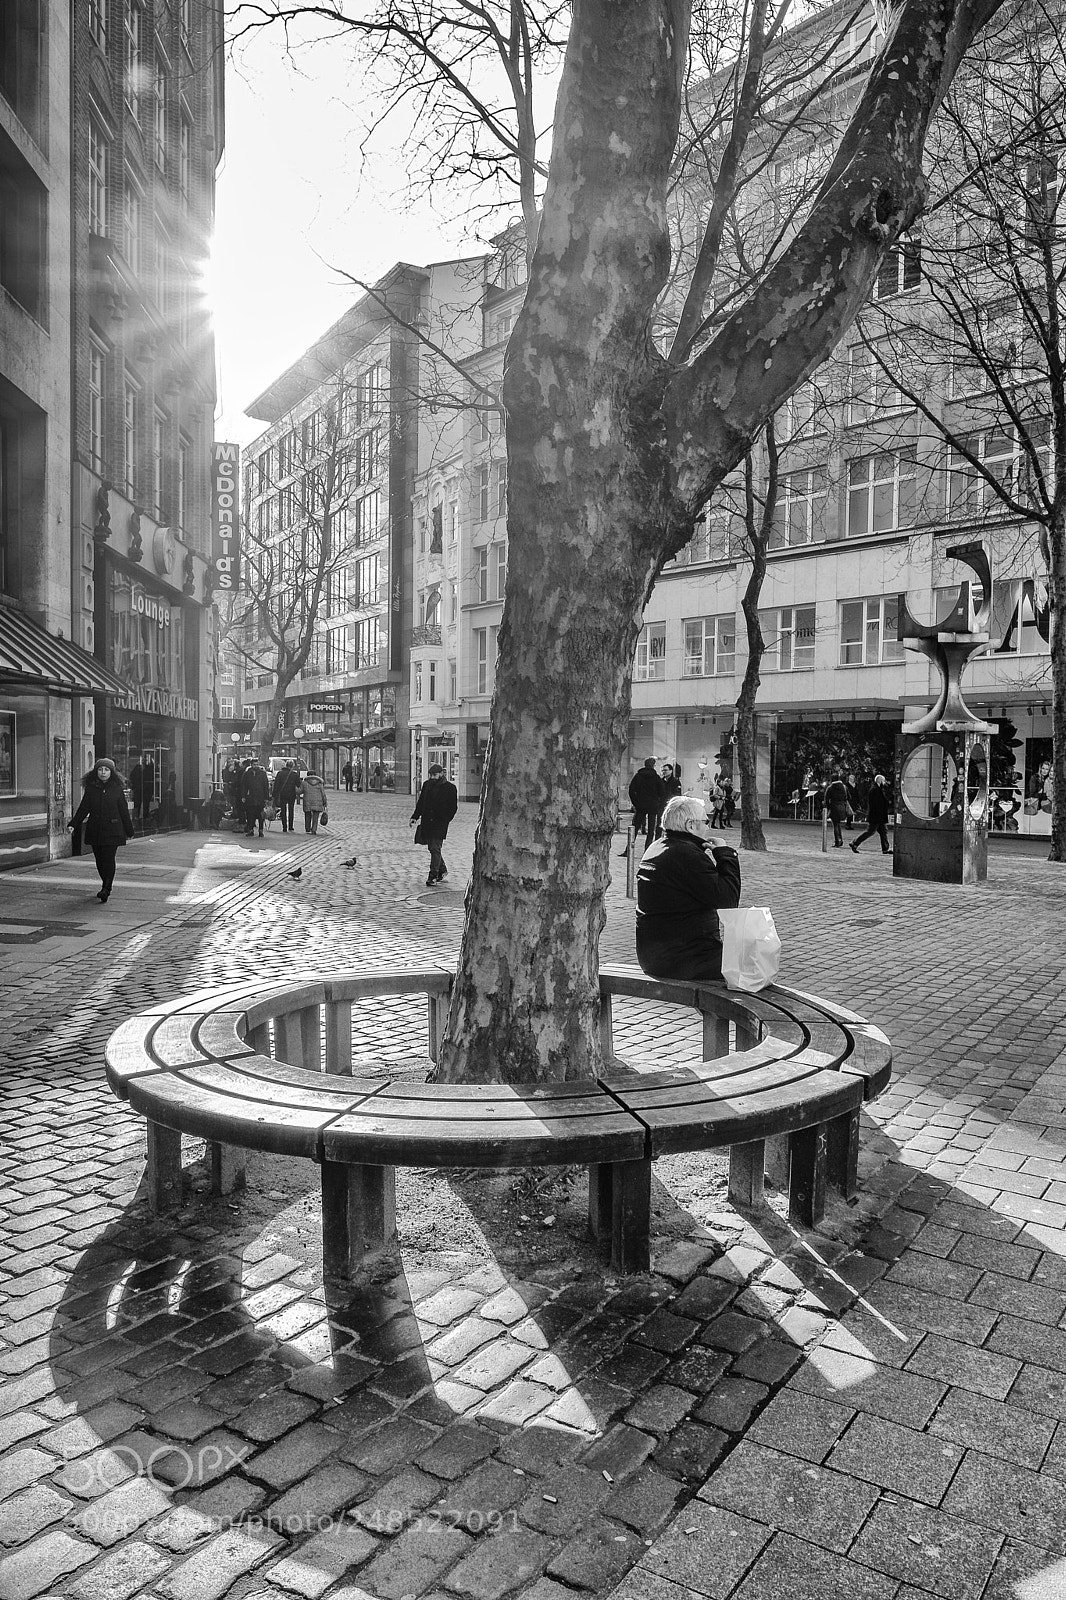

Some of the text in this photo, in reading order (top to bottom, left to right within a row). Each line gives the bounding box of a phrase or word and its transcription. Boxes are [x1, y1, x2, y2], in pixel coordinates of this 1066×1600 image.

[215, 445, 237, 588] McDonald's
[131, 585, 170, 629] Lounge
[310, 703, 343, 711] POPKEN
[305, 723, 325, 733] POPKEN
